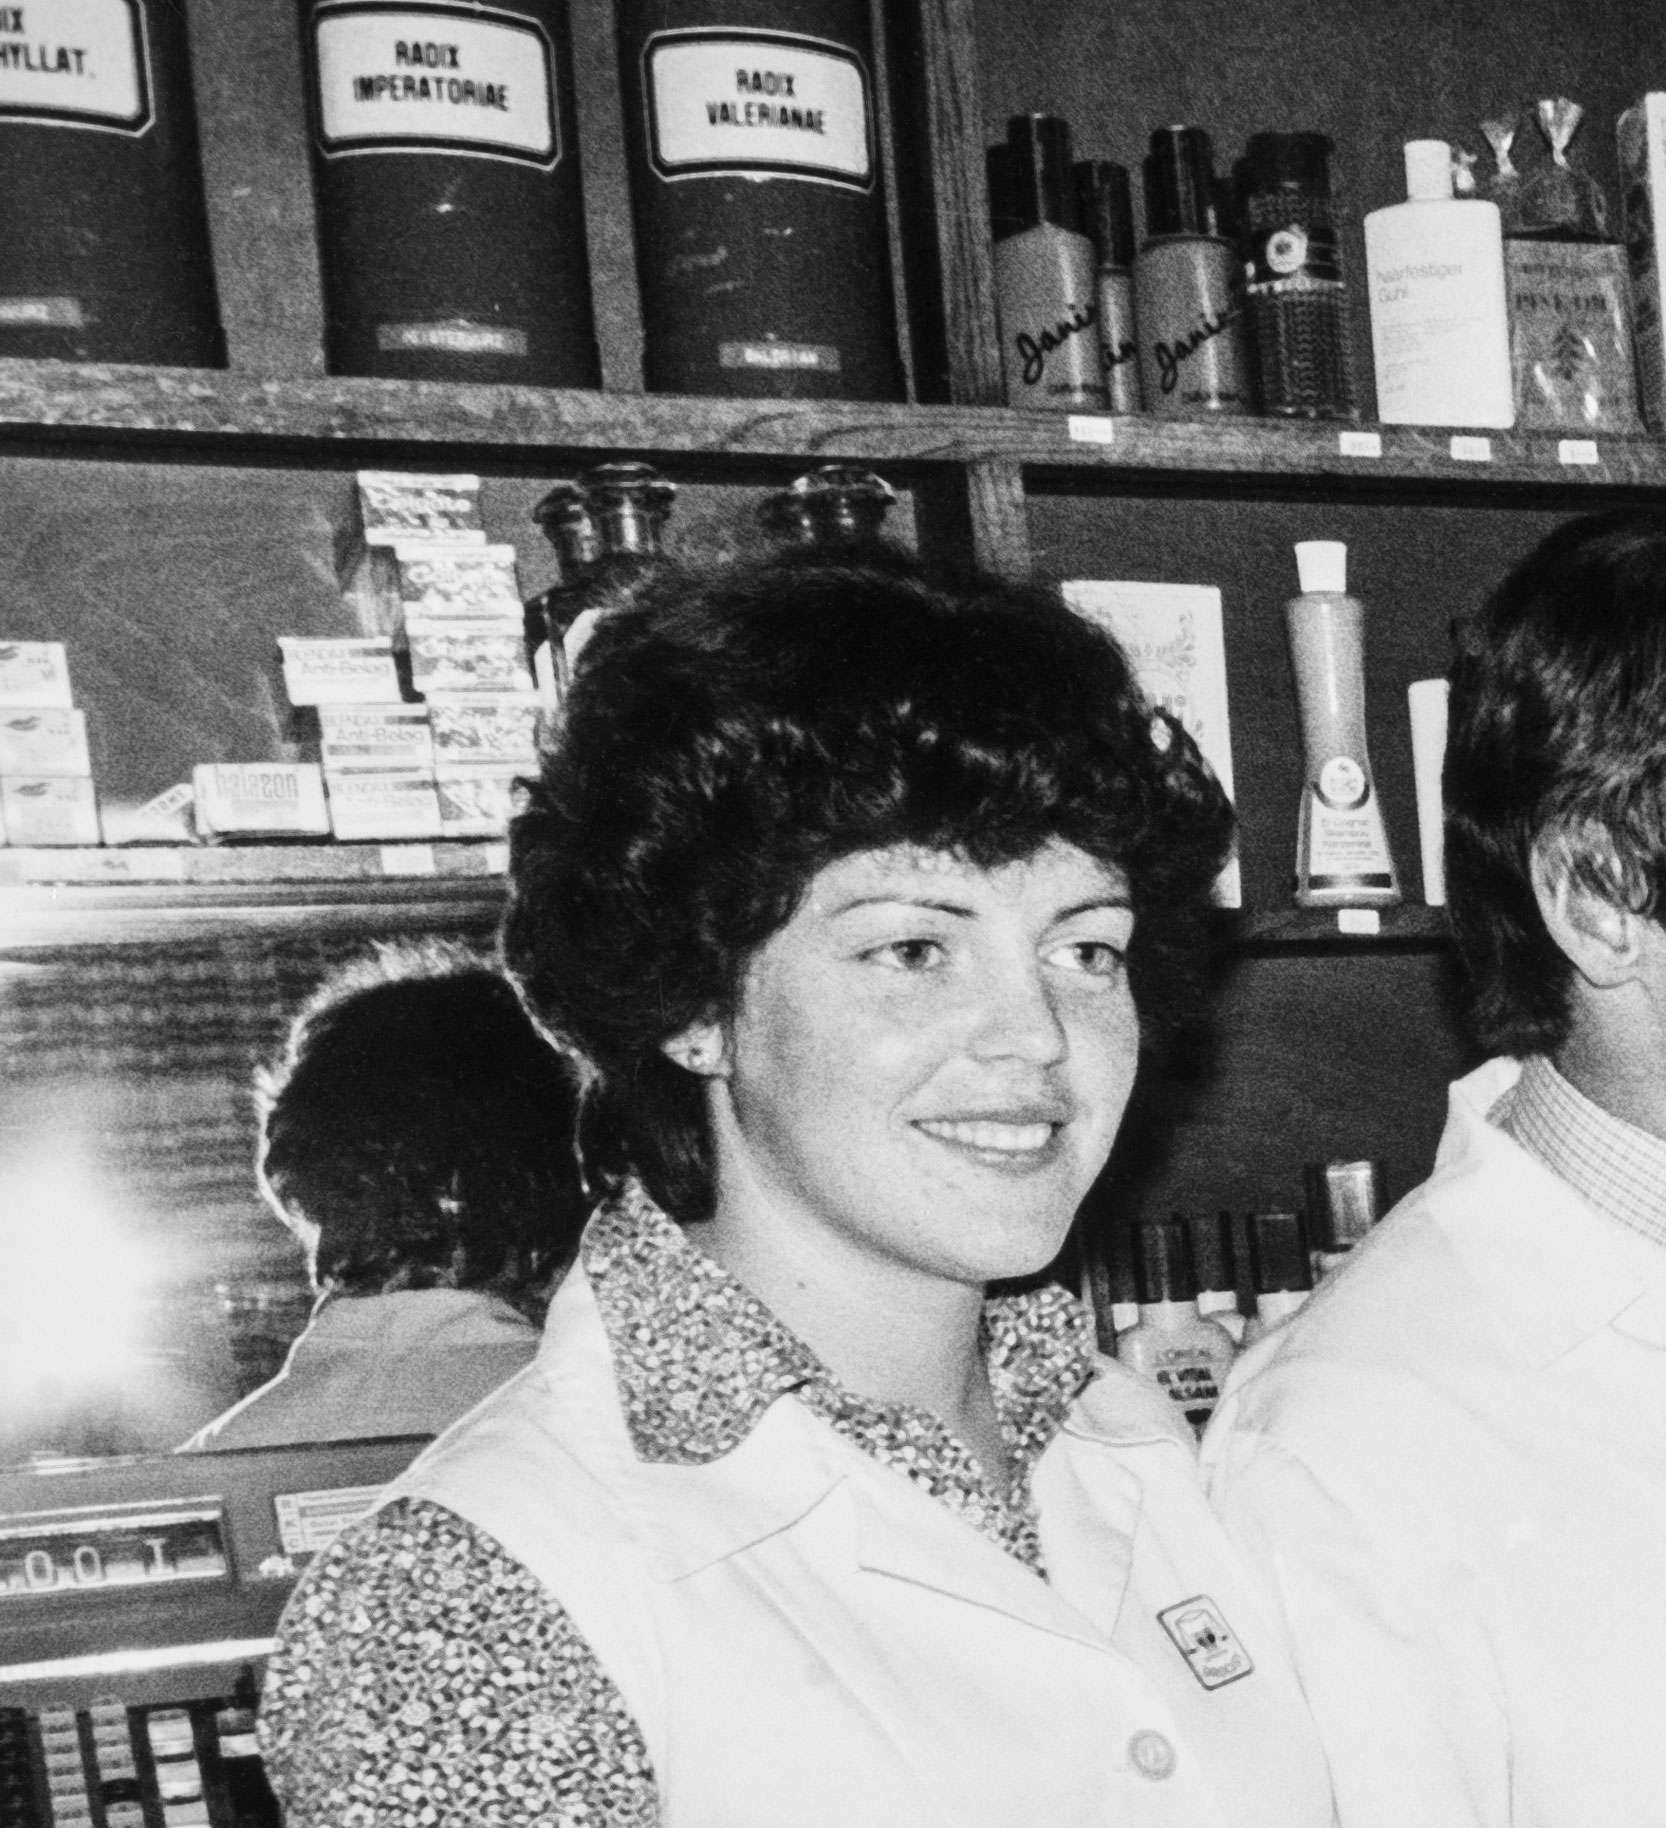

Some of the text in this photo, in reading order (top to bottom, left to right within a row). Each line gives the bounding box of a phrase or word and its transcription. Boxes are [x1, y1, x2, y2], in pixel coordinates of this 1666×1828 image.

[395, 40, 460, 70] RADIX
[352, 74, 510, 113] IMPERATORIAE
[734, 67, 797, 98] RADIX
[704, 101, 827, 136] VALERIANAE
